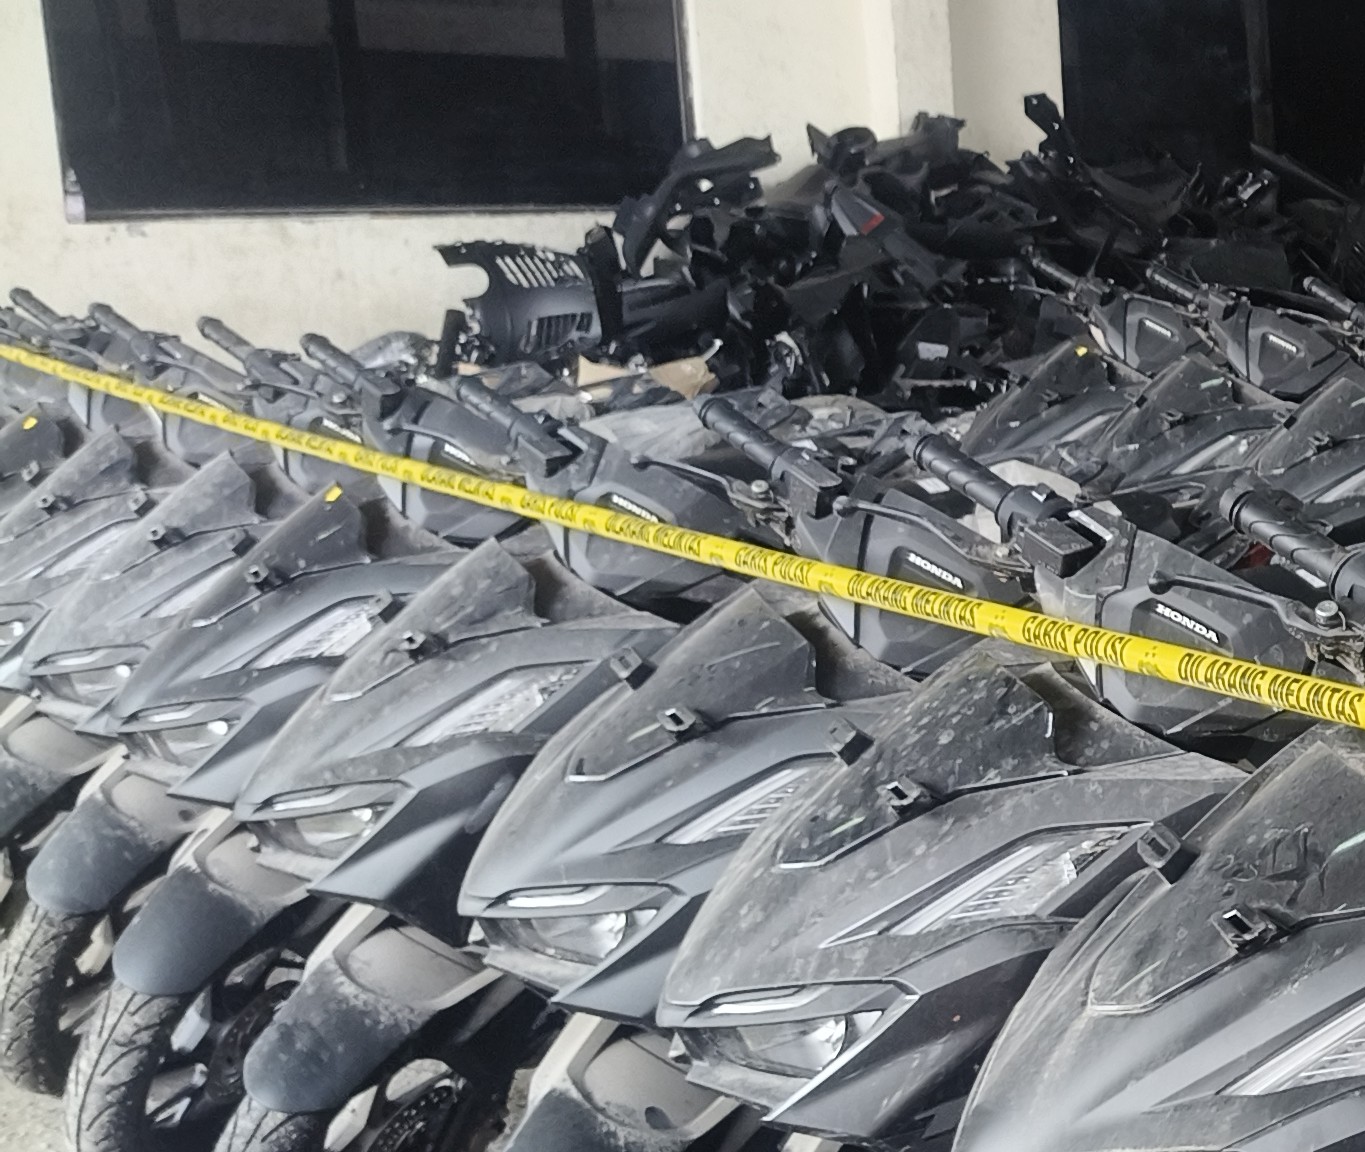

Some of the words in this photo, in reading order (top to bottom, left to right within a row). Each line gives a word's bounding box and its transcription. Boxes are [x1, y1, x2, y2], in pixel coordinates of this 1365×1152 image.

[907, 552, 964, 590] HONDA
[1022, 615, 1074, 653] GARIS
[1073, 627, 1133, 668] POLISI
[1155, 603, 1219, 644] HONDA
[1177, 652, 1268, 698] DILARANG
[1267, 673, 1365, 726] MELINTAS
